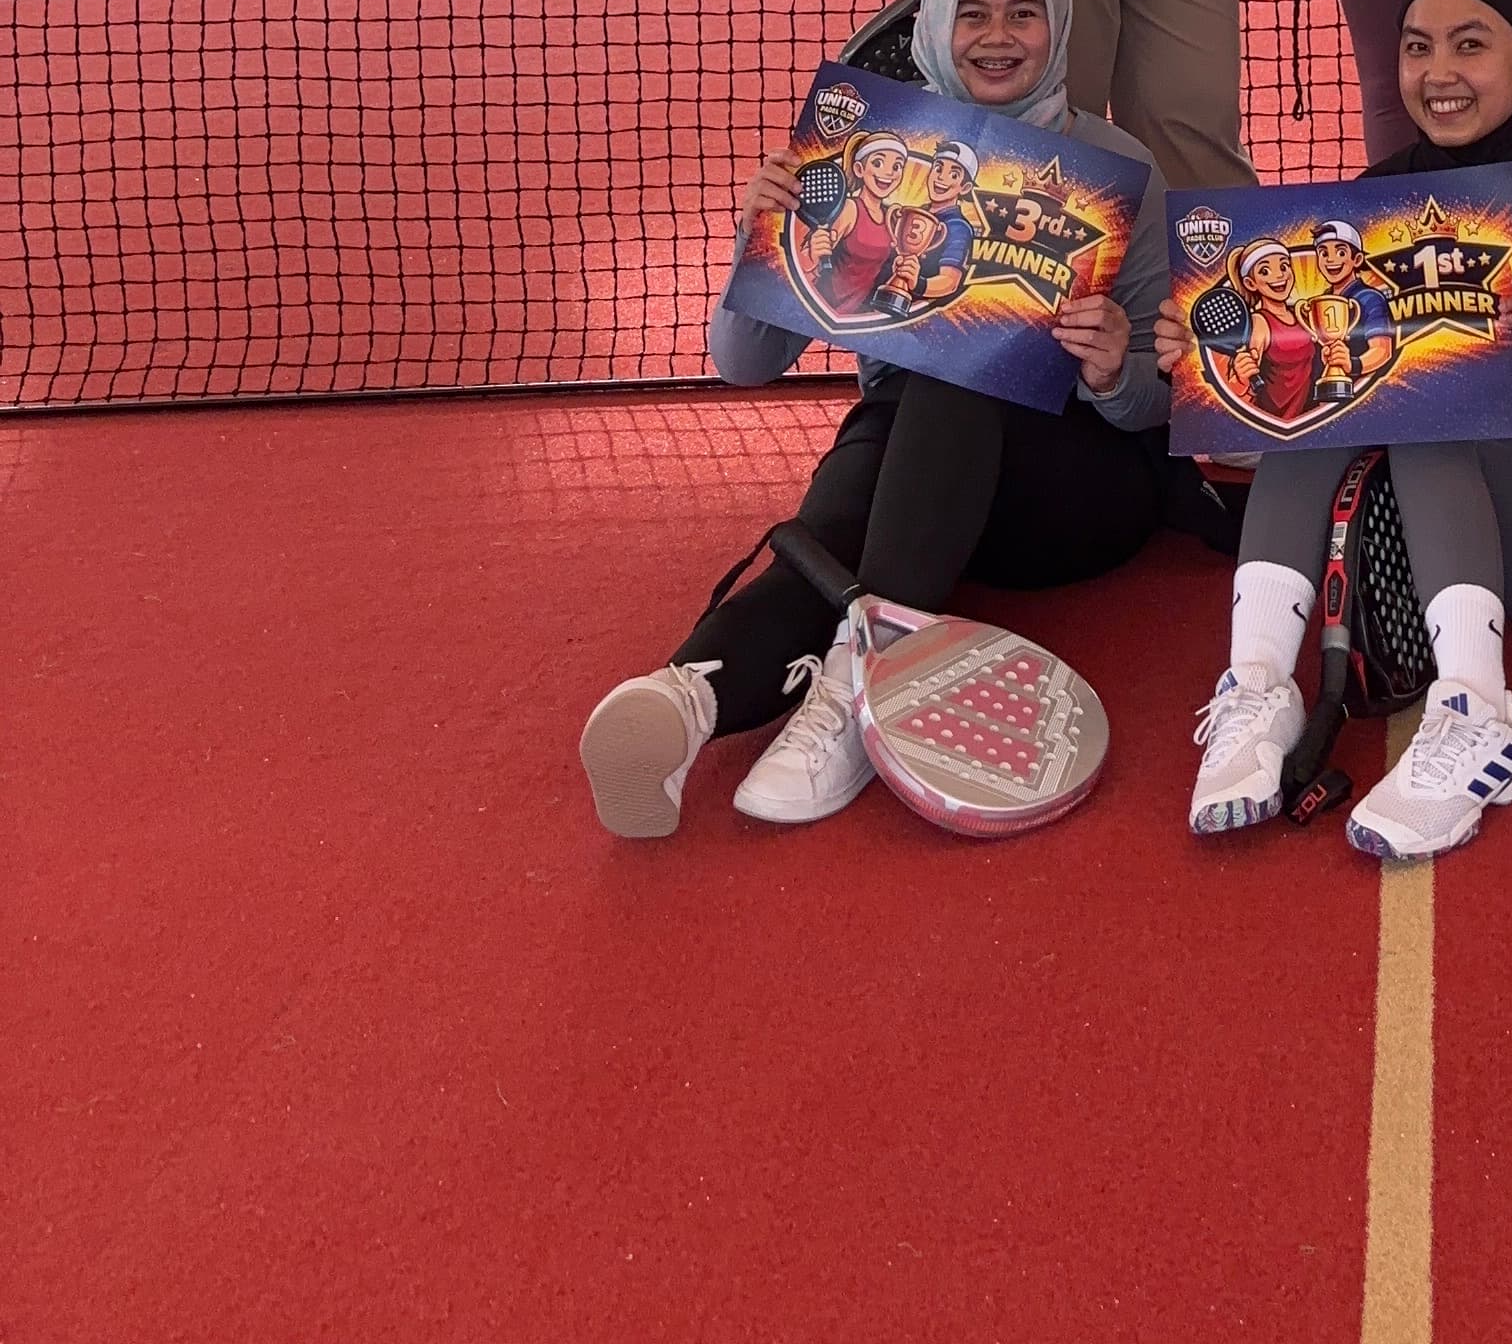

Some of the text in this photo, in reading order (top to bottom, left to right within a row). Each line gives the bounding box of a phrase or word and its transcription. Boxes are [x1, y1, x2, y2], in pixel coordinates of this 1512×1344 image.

[817, 92, 866, 117] UNITED
[905, 216, 928, 245] 3
[1005, 198, 1066, 243] 3rd
[1179, 220, 1230, 237] UNITED
[1186, 234, 1224, 243] PADEL CLUB
[972, 239, 1071, 289] WINNER
[1413, 245, 1465, 289] 1st
[1324, 305, 1340, 333] 1
[1388, 291, 1496, 321] WINNER
